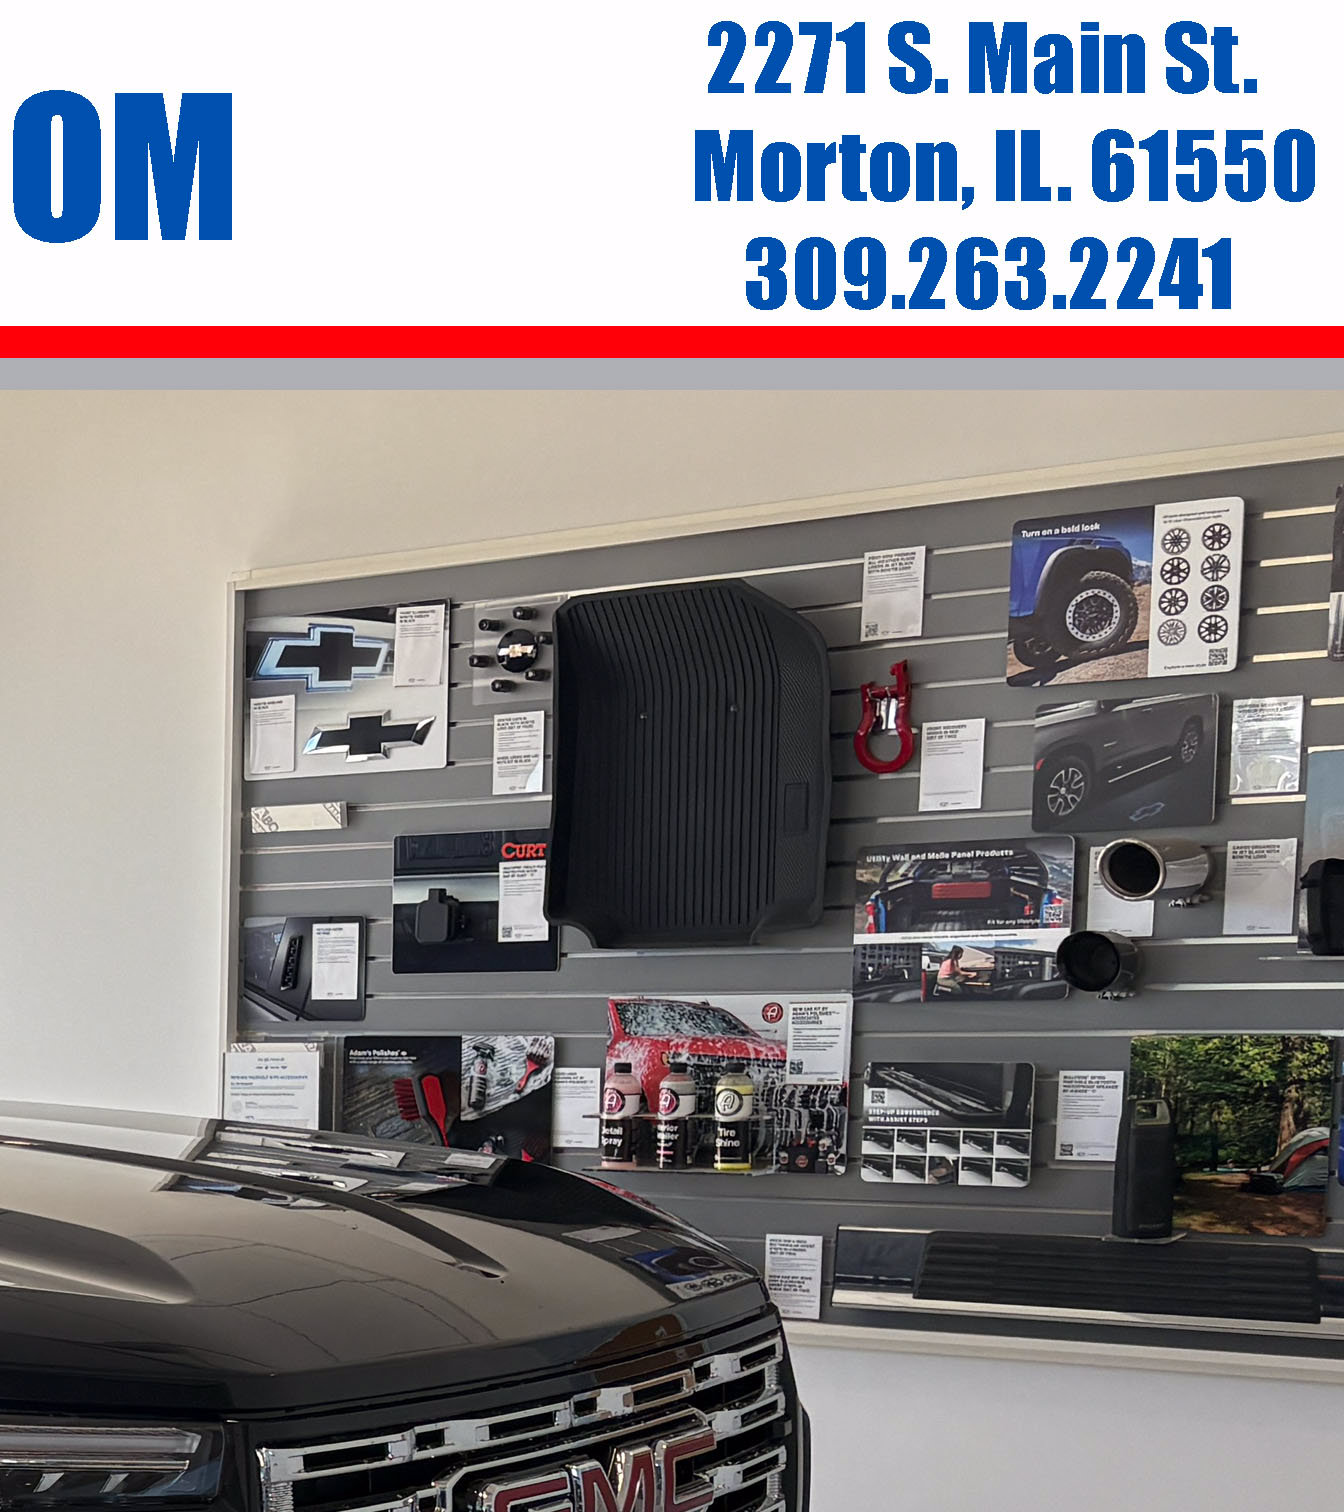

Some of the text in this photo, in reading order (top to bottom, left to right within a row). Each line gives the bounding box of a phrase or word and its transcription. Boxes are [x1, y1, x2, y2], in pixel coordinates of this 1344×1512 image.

[1021, 530, 1040, 538] Turn
[1061, 524, 1080, 534] bold
[1081, 522, 1101, 531] look
[501, 842, 547, 859] CURT
[866, 855, 890, 863] Utility
[892, 853, 910, 861] Wall
[912, 852, 926, 860] and
[951, 850, 974, 858] Panel
[717, 1127, 736, 1137] Tire
[715, 1138, 740, 1147] Shine
